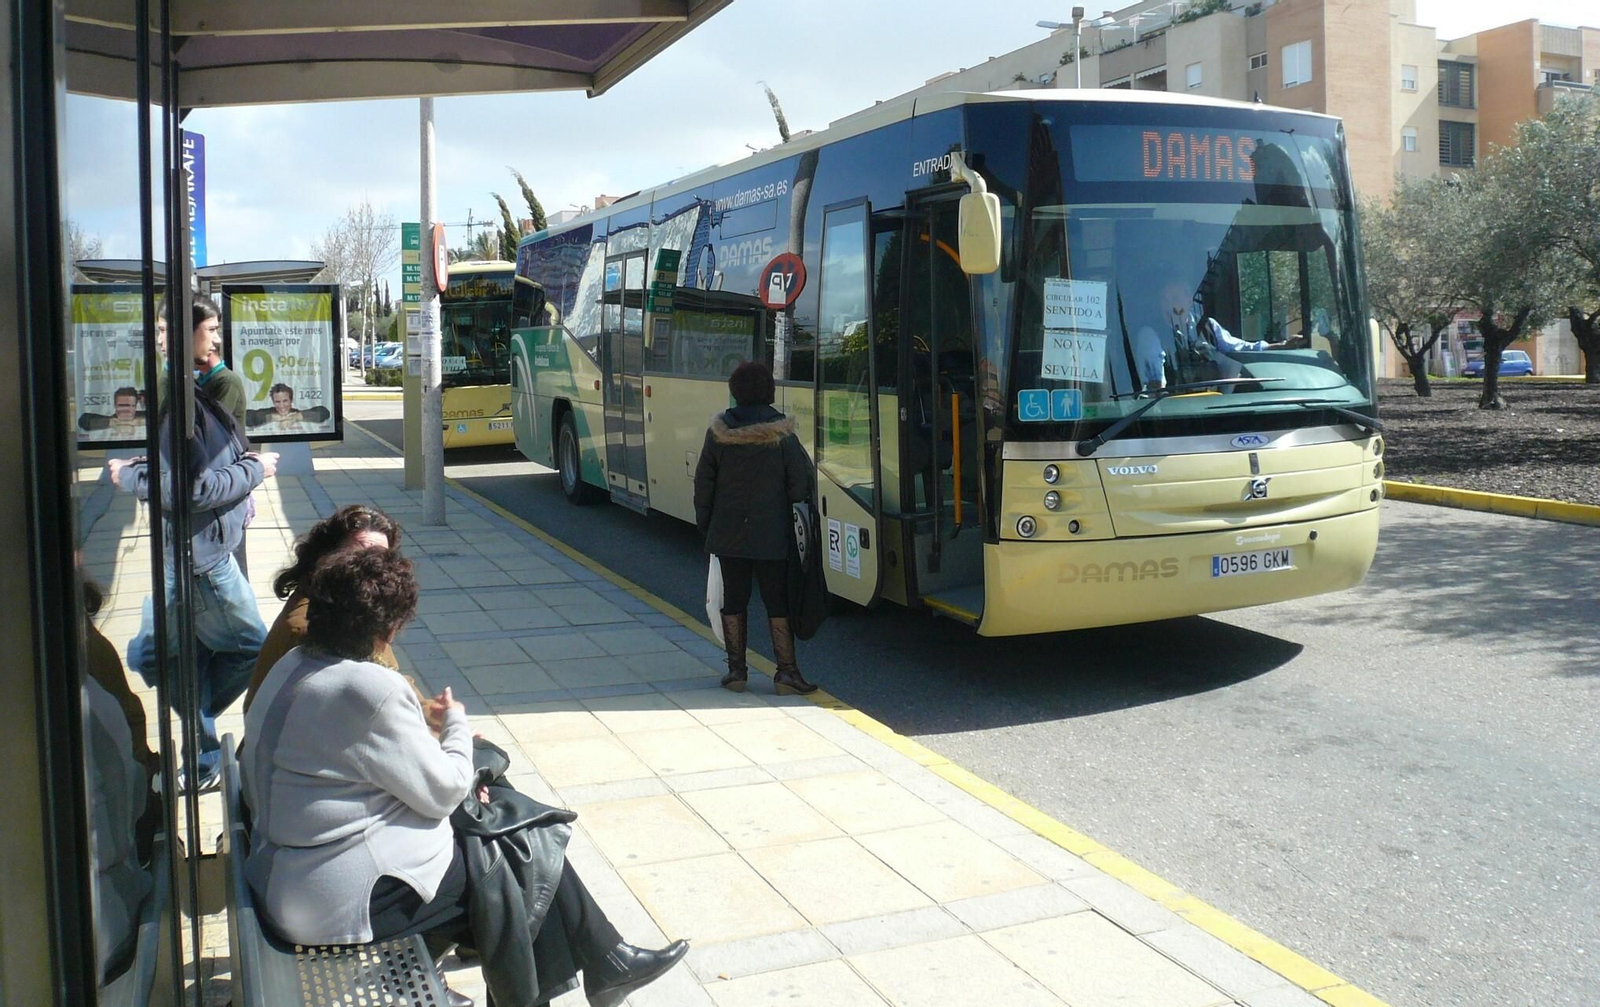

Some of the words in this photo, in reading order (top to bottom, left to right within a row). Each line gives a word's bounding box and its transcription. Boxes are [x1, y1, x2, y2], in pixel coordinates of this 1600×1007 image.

[1143, 131, 1256, 180] DAMAS
[913, 154, 954, 177] ENTRAD
[715, 179, 788, 212] www.damas-sa.es
[720, 236, 773, 268] DAMAS
[1045, 293, 1083, 303] CIRCULAR
[1086, 295, 1100, 304] 102
[1045, 306, 1092, 317] SENTIDO
[1095, 310, 1102, 318] A
[284, 326, 303, 335] este
[304, 326, 323, 335] mes
[240, 338, 246, 346] a
[248, 338, 284, 347] navegar
[286, 338, 301, 346] por
[1053, 338, 1073, 349] NO
[1076, 340, 1094, 352] VA
[1044, 364, 1098, 379] SEVILLA
[299, 389, 323, 400] 1422
[1107, 464, 1158, 475] VOLVO
[1220, 554, 1258, 574] 0596
[1263, 549, 1289, 569] GKM
[1057, 557, 1179, 584] DAMAS
